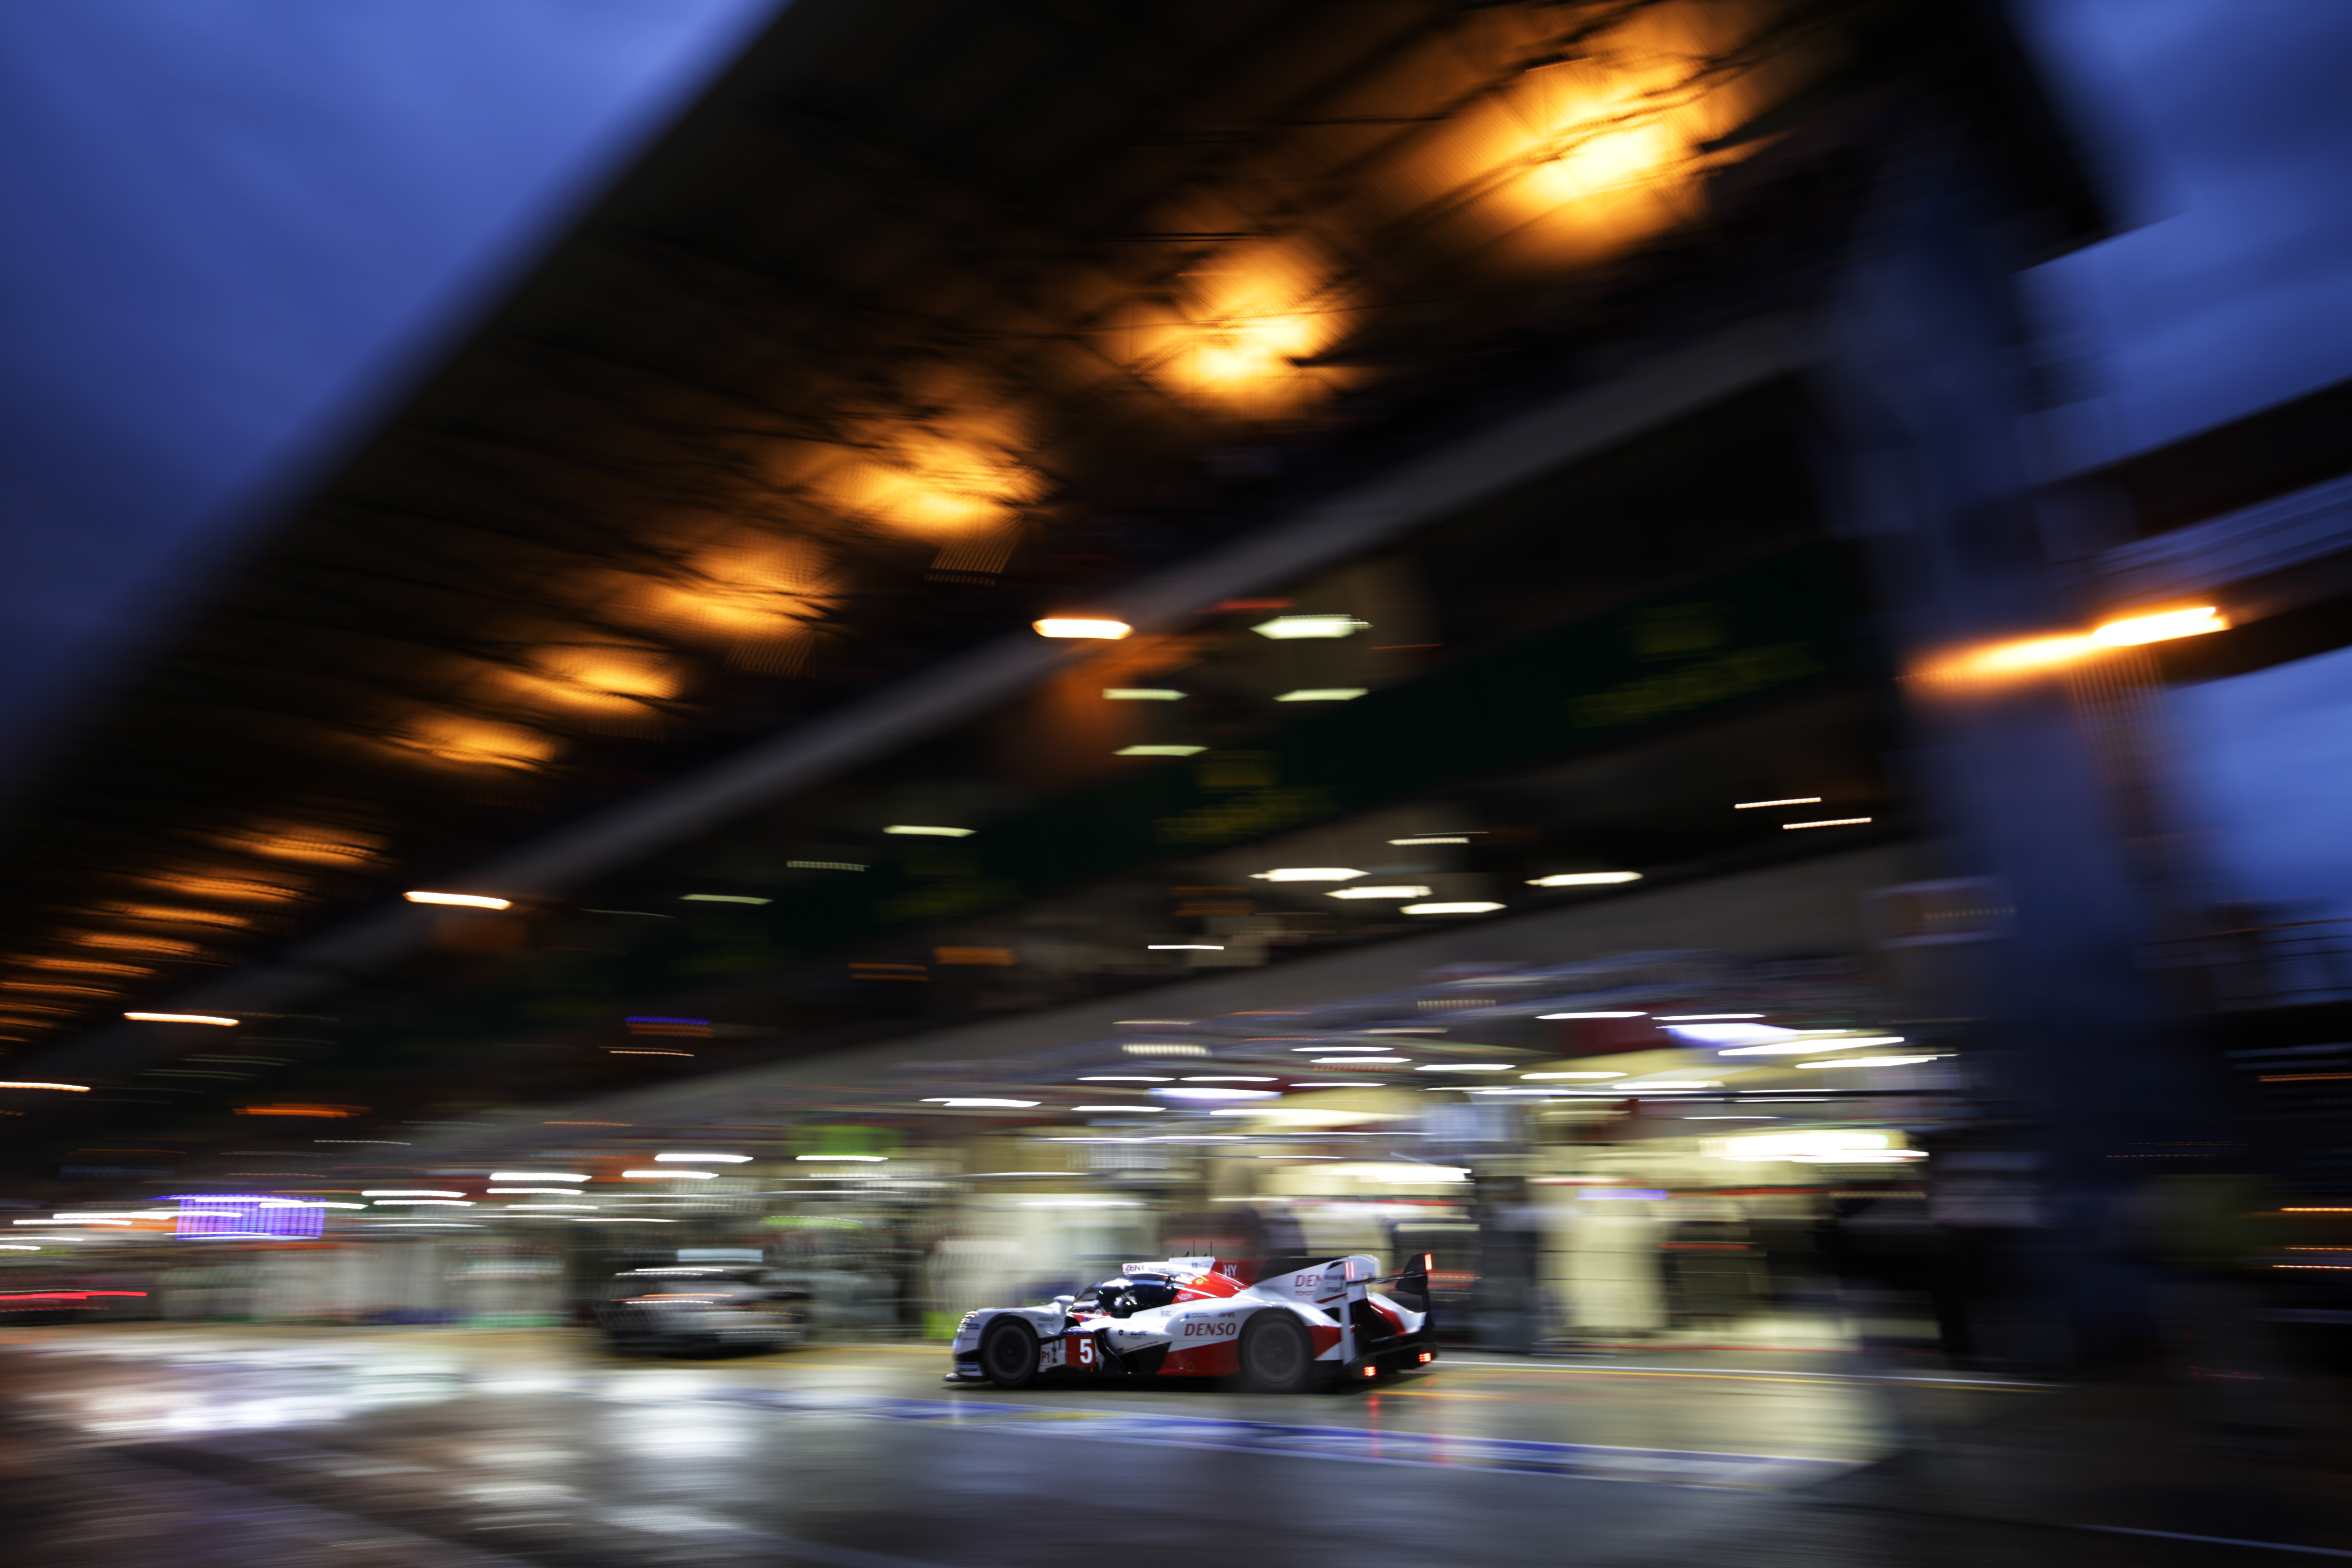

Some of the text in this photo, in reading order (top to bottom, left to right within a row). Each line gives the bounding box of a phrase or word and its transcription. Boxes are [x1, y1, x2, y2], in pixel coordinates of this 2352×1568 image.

[1224, 1264, 1237, 1276] HY
[1184, 1323, 1236, 1336] DENSO
[1080, 1338, 1093, 1363] 5
[1041, 1351, 1050, 1363] P1
